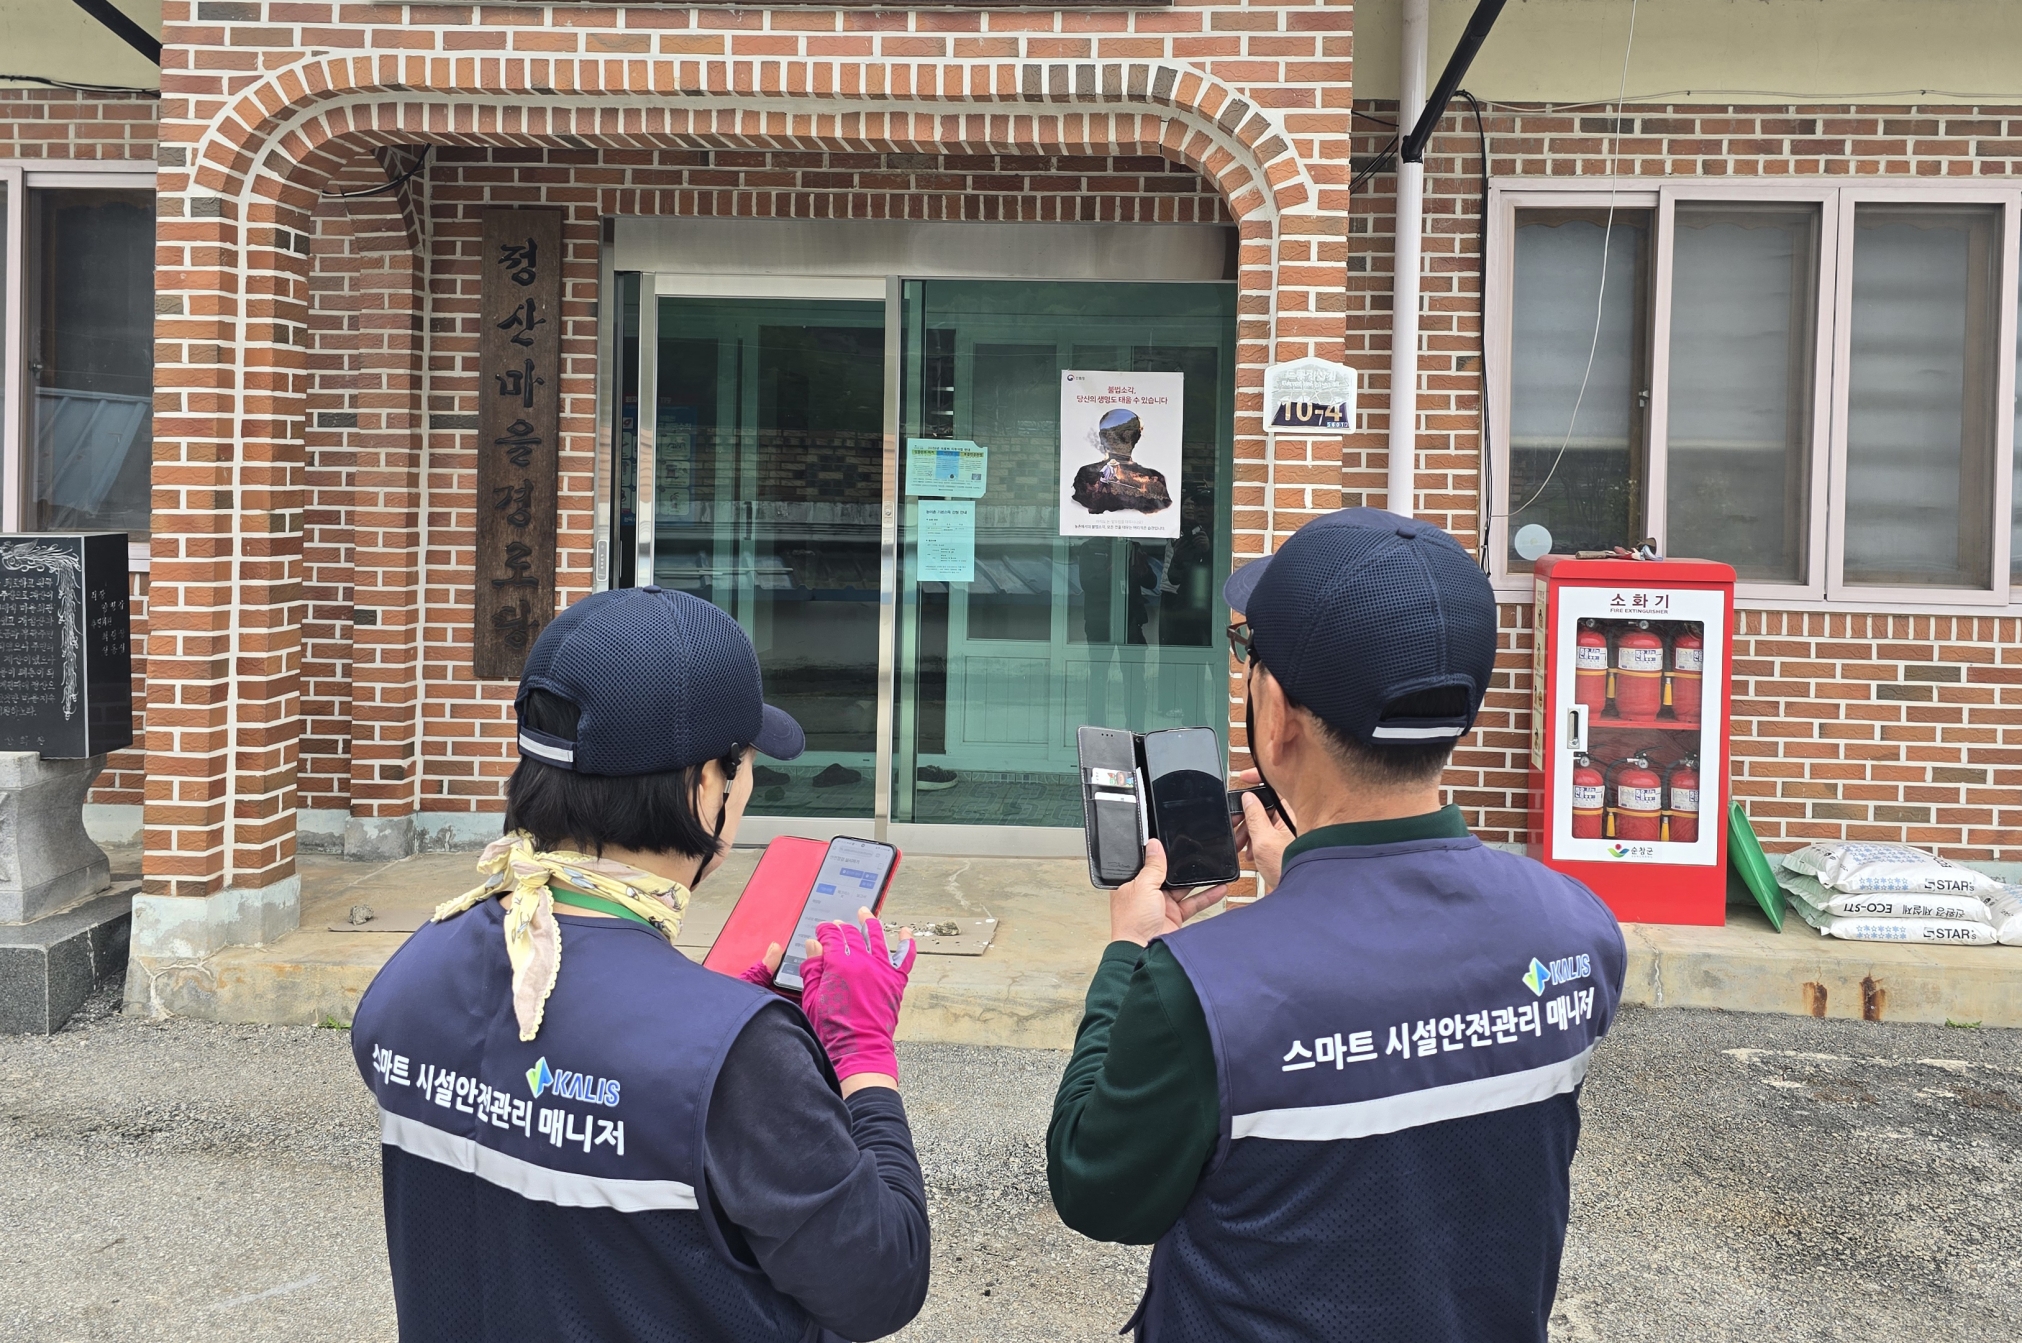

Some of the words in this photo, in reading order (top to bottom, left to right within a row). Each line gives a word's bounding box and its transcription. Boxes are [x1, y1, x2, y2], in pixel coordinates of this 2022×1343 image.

[1108, 386, 1136, 394] 불법소각,
[1280, 397, 1342, 422] 10-4
[1610, 593, 1669, 608] 소화기
[1902, 904, 1932, 915] 제설제
[1935, 907, 1965, 918] 친환경
[1550, 954, 1591, 985] KALIS
[1282, 1030, 1378, 1071] 스마트
[1385, 1001, 1541, 1060] 시설안전관리
[1546, 987, 1594, 1031] 매니저
[372, 1043, 410, 1086] 스마트
[416, 1064, 532, 1138] 시설안전관리
[538, 1108, 624, 1156] 매니저
[552, 1069, 620, 1107] KALIS
